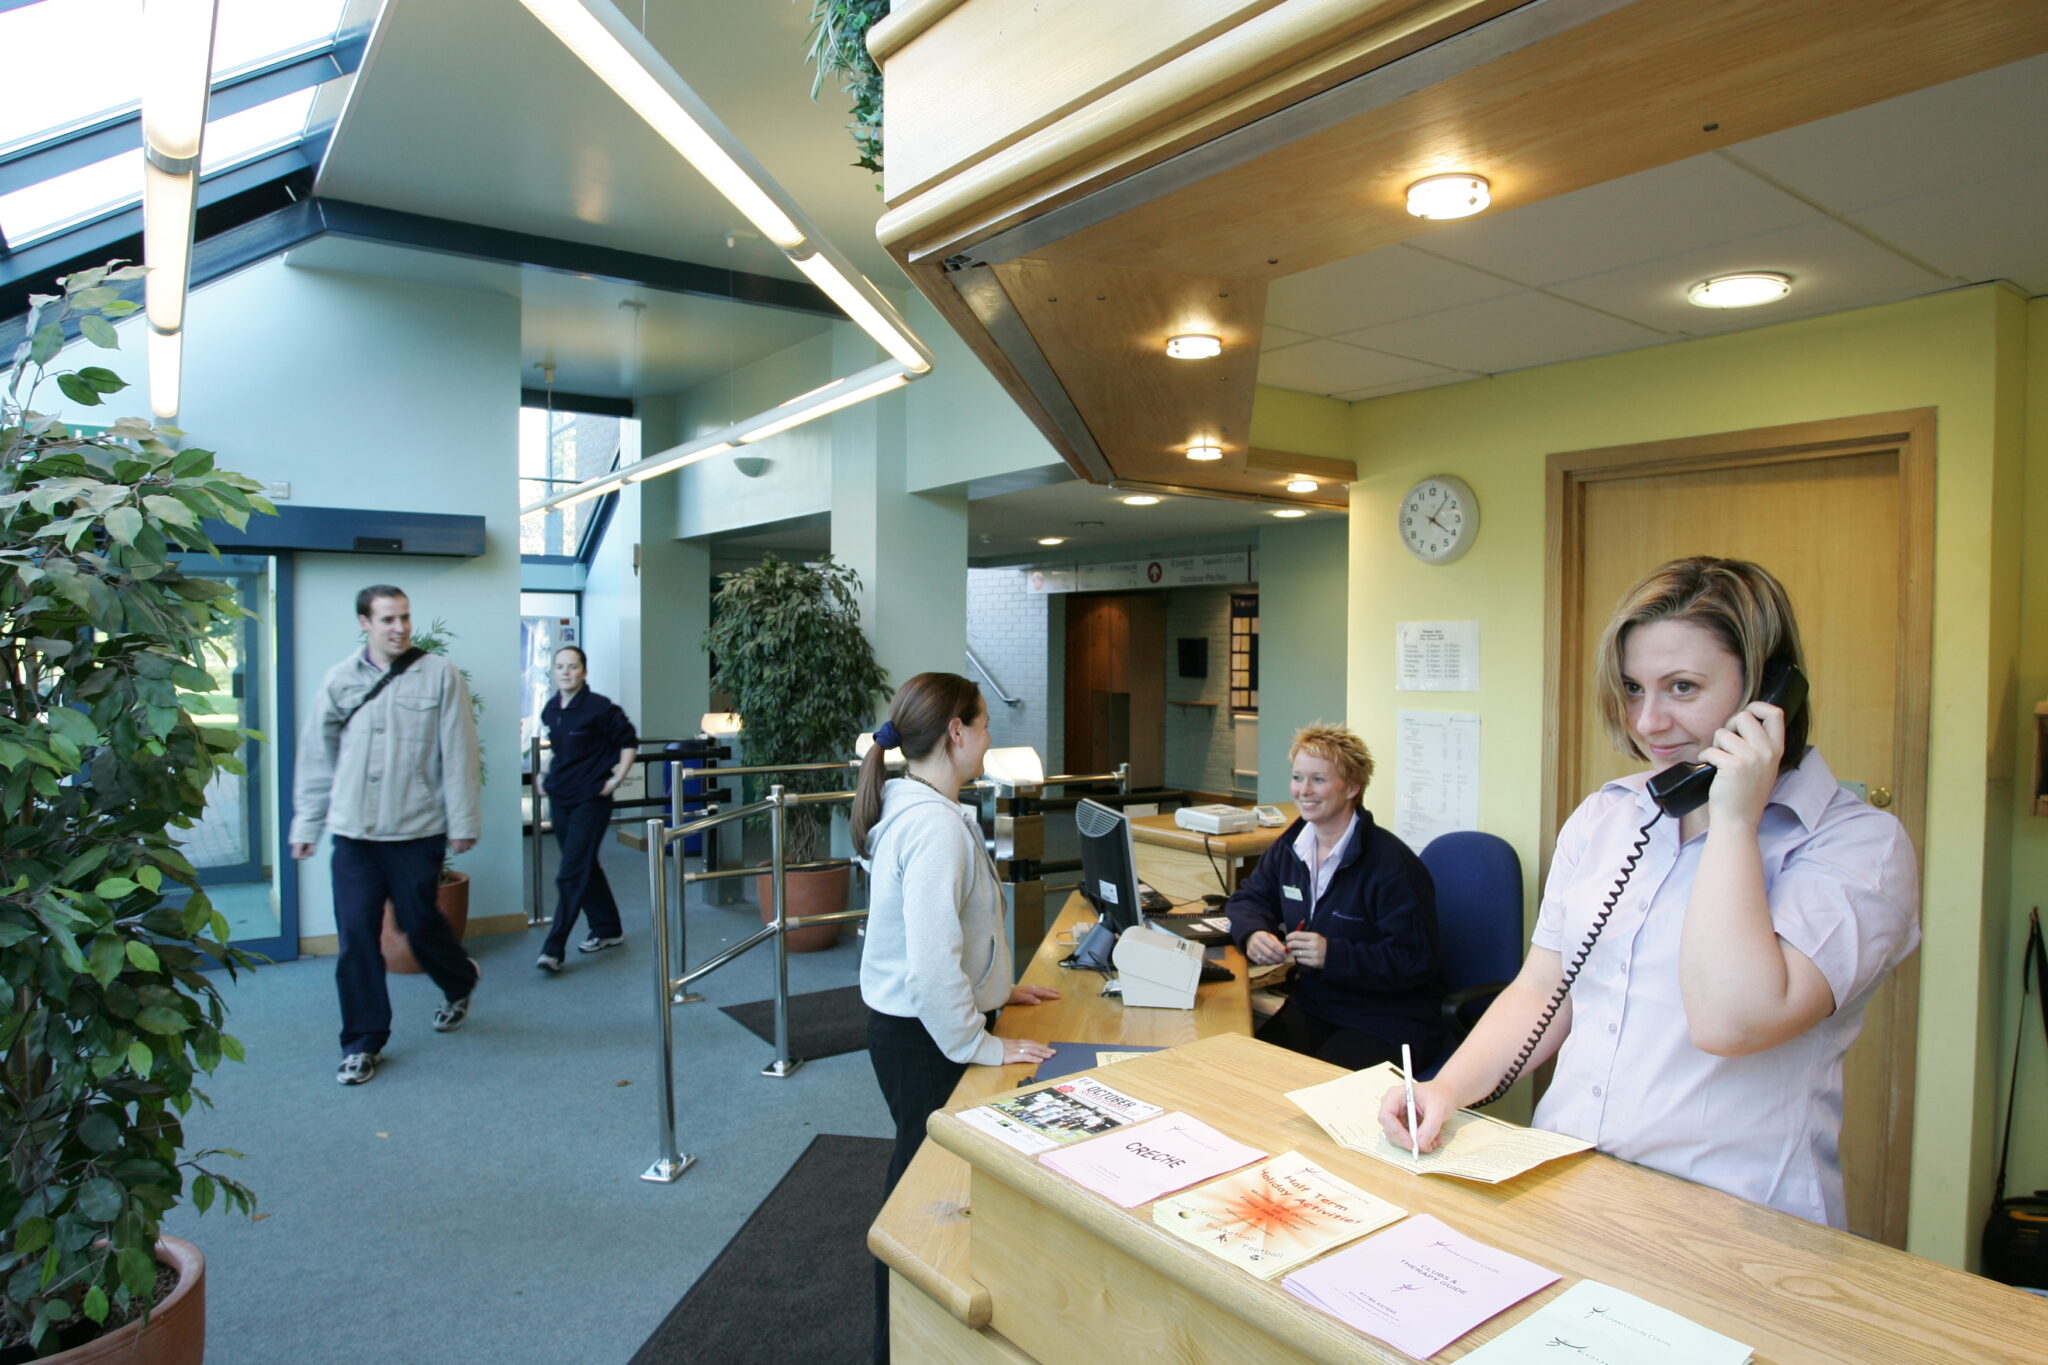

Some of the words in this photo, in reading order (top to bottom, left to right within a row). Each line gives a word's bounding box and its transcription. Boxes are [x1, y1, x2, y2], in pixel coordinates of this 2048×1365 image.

[1429, 487, 1437, 496] 12
[1419, 492, 1425, 501] 11
[1410, 503, 1419, 512] 10
[1451, 500, 1457, 509] 2
[1406, 517, 1413, 526] 9
[1455, 514, 1462, 523] 3
[1411, 531, 1417, 539] 8
[1450, 528, 1457, 537] 4
[1419, 540, 1425, 549] 7
[1443, 538, 1449, 547] 5
[1431, 543, 1437, 552] 6
[1179, 574, 1204, 584] Outdoor
[1087, 1086, 1136, 1107] OCTOBER
[1126, 1141, 1187, 1169] CRECHE
[1261, 1168, 1294, 1196] Holiday
[1283, 1175, 1312, 1192] Half
[1314, 1192, 1348, 1211] Term
[1206, 1222, 1257, 1242] Basketball
[1241, 1243, 1285, 1259] Football
[1420, 1263, 1450, 1281] CLUBS
[1400, 1258, 1440, 1282] THERAPY
[1440, 1279, 1469, 1296] GUIDE
